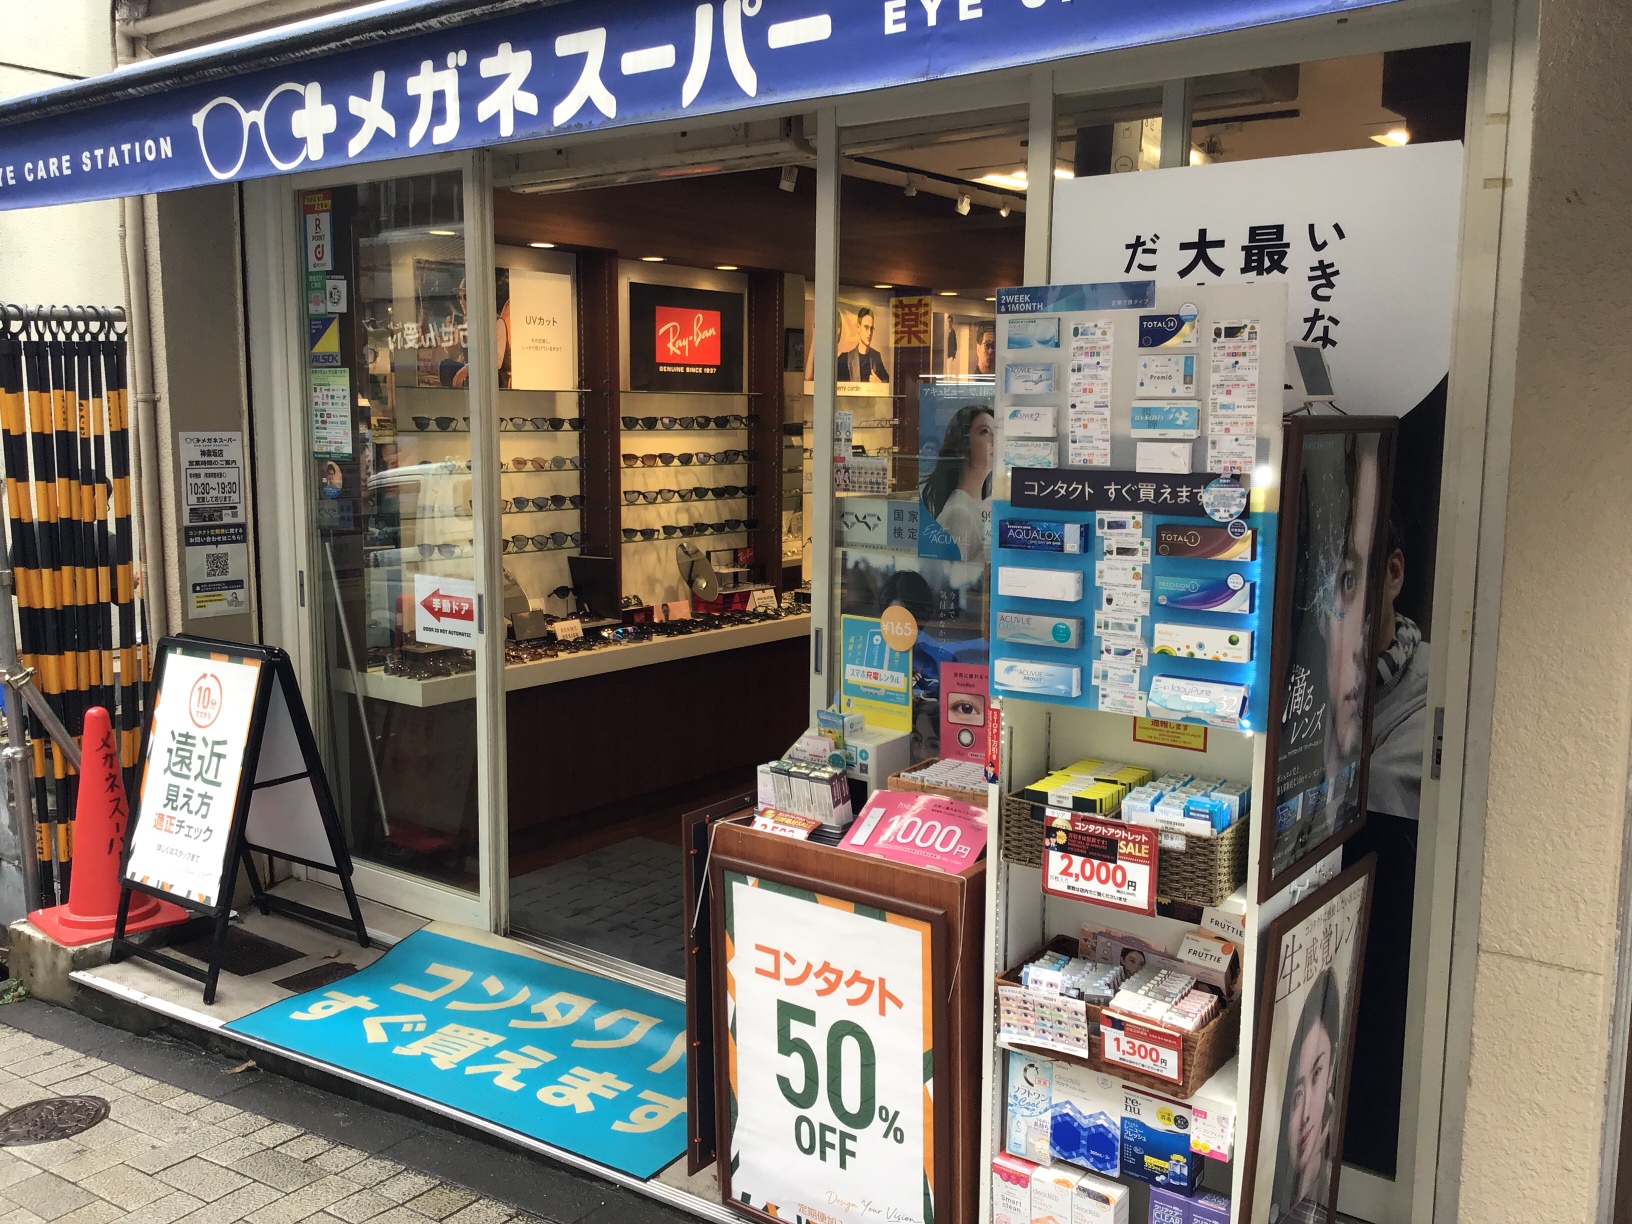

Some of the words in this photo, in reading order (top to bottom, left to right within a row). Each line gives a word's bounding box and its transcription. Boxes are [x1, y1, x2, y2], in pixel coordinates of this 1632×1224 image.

[348, 0, 831, 158] メガネスーパー
[24, 155, 72, 183] CARE
[82, 136, 173, 173] STATION
[312, 233, 326, 242] POINT
[1124, 233, 1160, 275] だ
[1177, 228, 1226, 279] 大
[1240, 223, 1290, 277] 最
[1302, 222, 1345, 350] いきな
[1001, 294, 1031, 303] 2WEEK
[1007, 302, 1043, 312] 1MONTH
[525, 315, 557, 327] UVカット
[311, 354, 339, 364] ALSOK
[685, 366, 703, 374] SINCE
[1024, 480, 1094, 500] コンタクト
[894, 509, 918, 523] 国家
[893, 526, 918, 540] 検定
[1008, 529, 1062, 542] AQUALOX
[432, 598, 469, 615] 手動ドア
[882, 620, 912, 637] ¥165
[999, 615, 1032, 625] ACUVUE
[448, 630, 472, 638] AUTOMATIC
[850, 667, 900, 685] スマホ充電レンタル
[1019, 669, 1043, 677] ACUVUE
[197, 686, 217, 710] 10分
[1216, 696, 1239, 713] 32
[1282, 668, 1314, 724] 滴る
[1150, 719, 1189, 731] 通報します
[1291, 703, 1326, 745] レンズ
[163, 730, 227, 788] 遠近
[163, 783, 213, 820] 見え方
[1050, 810, 1067, 818] クリア
[153, 812, 213, 843] 適正チェック
[1075, 822, 1148, 843] コンタクトアウトレット
[156, 843, 200, 863] 詳しくはスタッフまで
[1119, 841, 1150, 858] SALE
[1059, 854, 1137, 892] 2,000円
[1209, 917, 1244, 938] FRUTTIE
[1187, 948, 1223, 964] FRUTTIE
[755, 943, 904, 1017] コンタクト
[1113, 1036, 1168, 1067] 1,300円
[289, 990, 688, 1134] すぐ買えます
[1012, 1085, 1048, 1102] ソフトワン
[1018, 1098, 1041, 1109] Cool
[1124, 1104, 1141, 1116] nu
[794, 1114, 858, 1171] OFF
[1123, 1131, 1147, 1142] フレッシュ
[825, 1190, 858, 1212] Design
[861, 1199, 882, 1217] Your
[886, 1206, 922, 1222] Vision
[1001, 1195, 1023, 1207] Smart
[1002, 1202, 1021, 1214] clean
[1154, 1212, 1181, 1224] CLEAR
